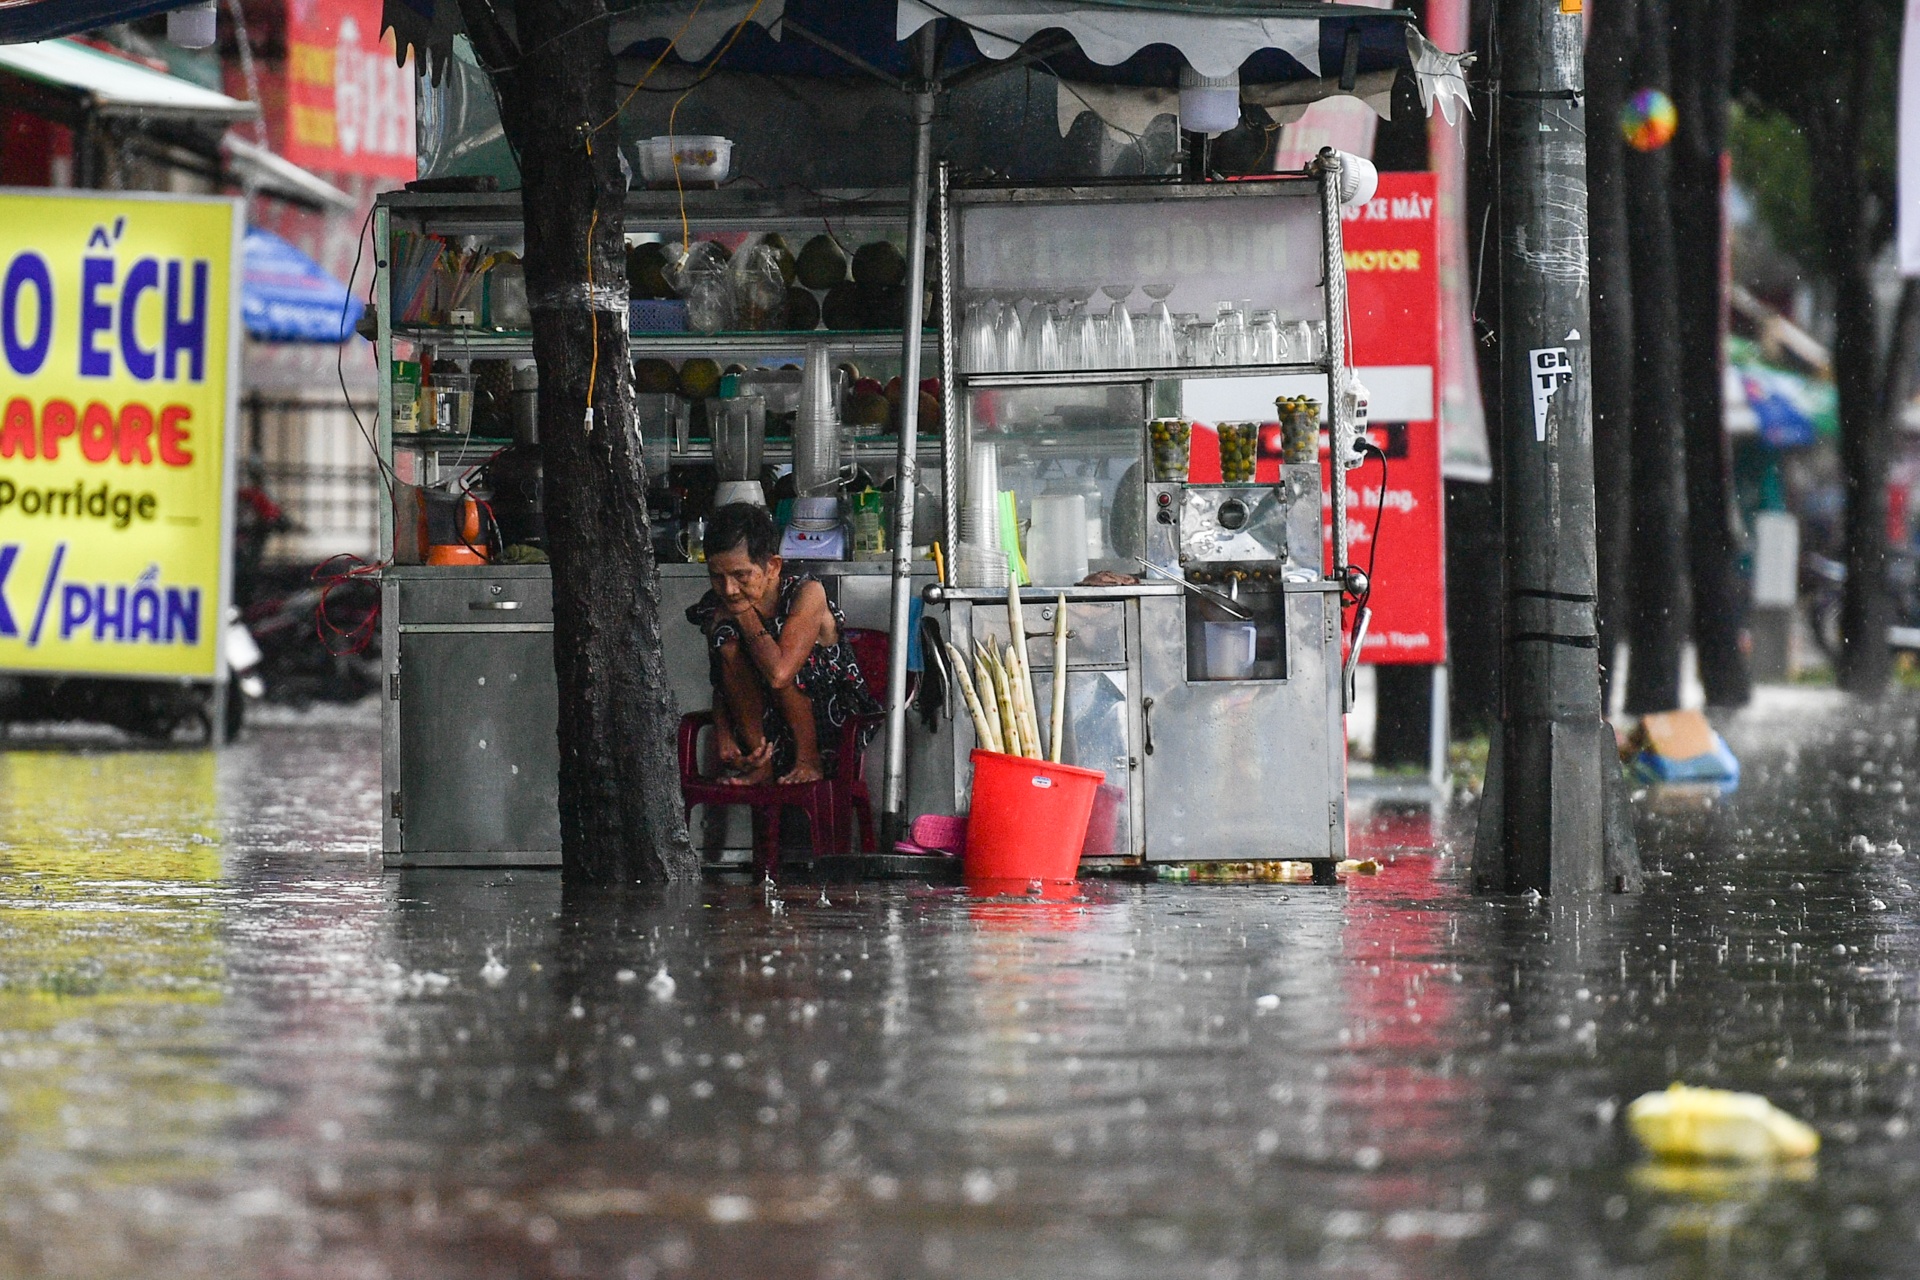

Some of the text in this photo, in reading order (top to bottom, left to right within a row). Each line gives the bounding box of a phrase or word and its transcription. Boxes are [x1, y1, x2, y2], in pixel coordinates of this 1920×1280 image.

[1366, 198, 1388, 220] XE
[1343, 249, 1421, 270] MOTOR
[79, 216, 208, 381] ẾCH
[0, 397, 194, 468] APORE
[0, 479, 157, 529] Porridge
